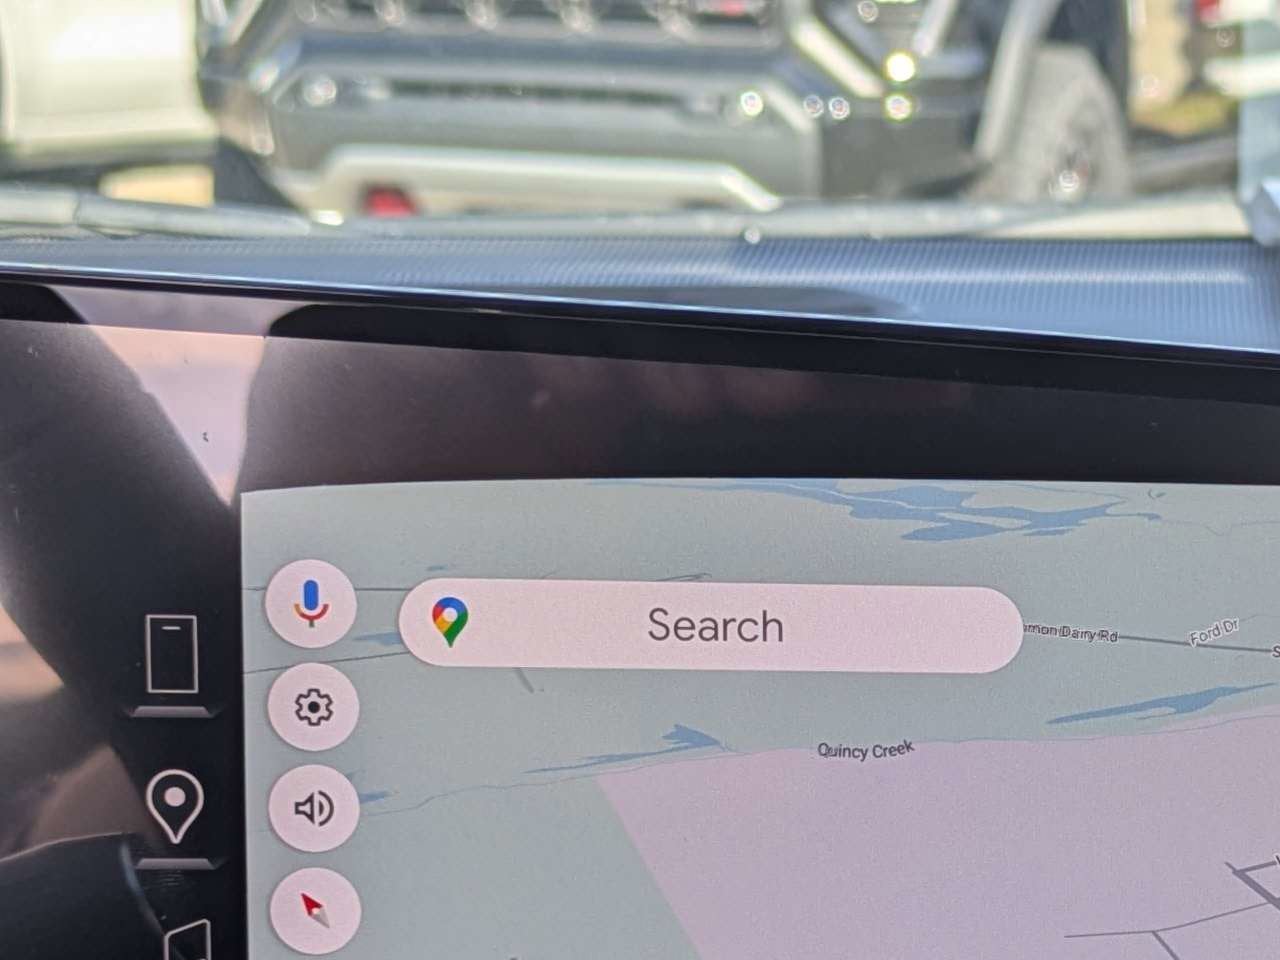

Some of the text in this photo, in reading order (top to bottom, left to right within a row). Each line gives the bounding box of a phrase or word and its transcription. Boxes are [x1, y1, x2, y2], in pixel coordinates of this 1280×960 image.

[648, 607, 784, 642] Search
[1099, 629, 1118, 642] Rd
[1190, 619, 1240, 646] Ford Dr
[817, 739, 915, 762] Quincy Creek
